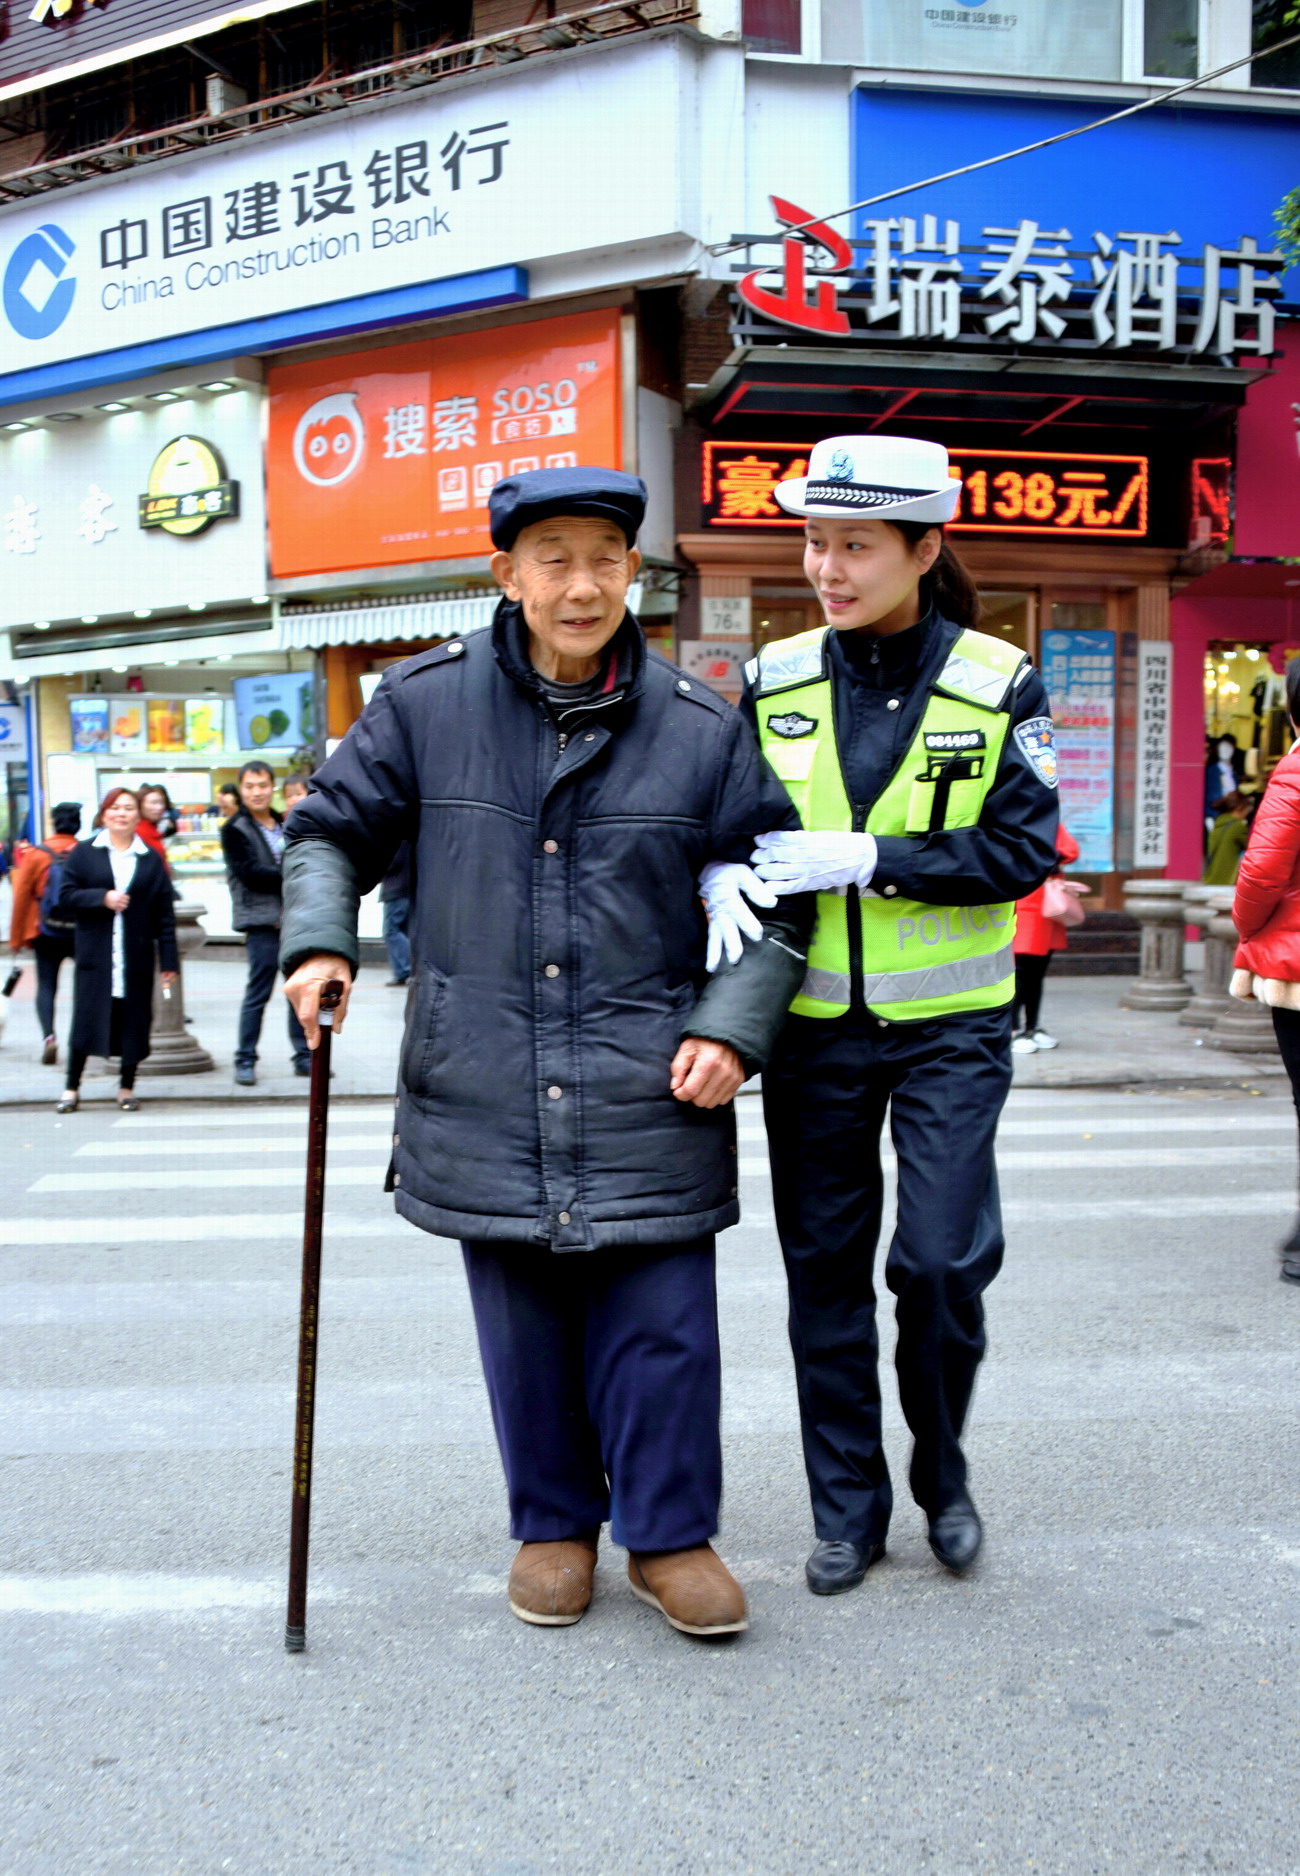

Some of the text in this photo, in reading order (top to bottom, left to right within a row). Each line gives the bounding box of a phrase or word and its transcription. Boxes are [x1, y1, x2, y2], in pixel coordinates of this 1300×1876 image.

[100, 120, 511, 270] 中国建设银行
[101, 205, 452, 311] China Construction Bank
[862, 213, 1286, 358] 瑞泰酒店
[383, 396, 480, 459] 搜索
[491, 378, 578, 417] SOSO
[948, 465, 1143, 526] 138元/
[897, 904, 1007, 950] POLICE
